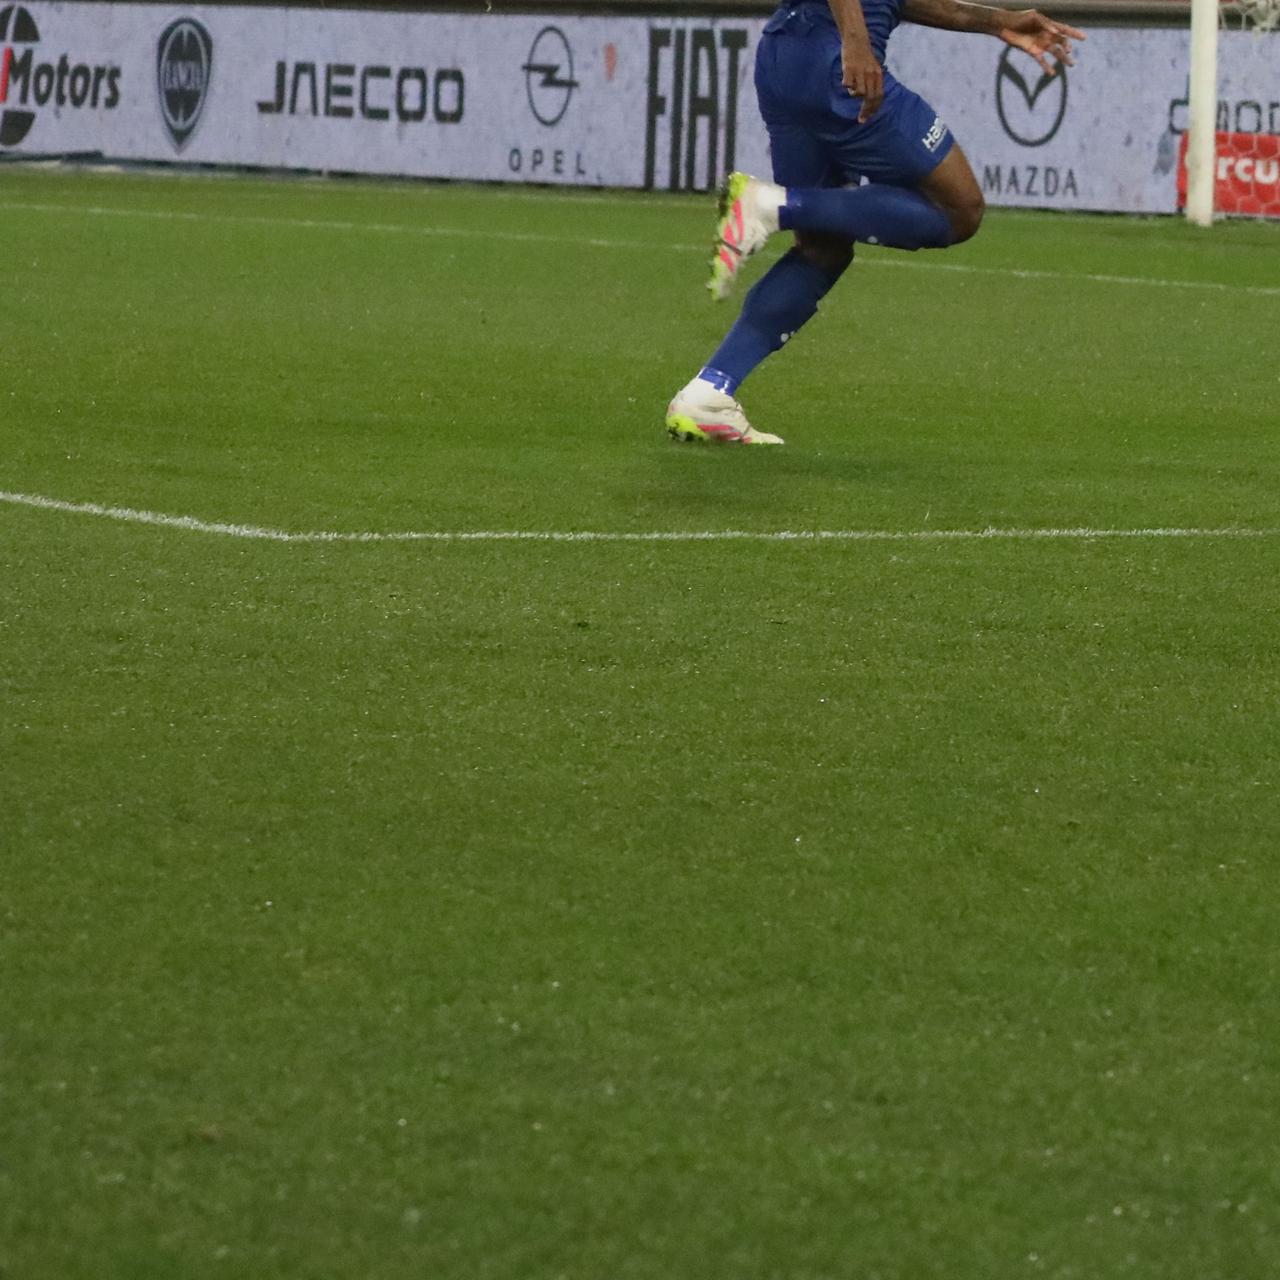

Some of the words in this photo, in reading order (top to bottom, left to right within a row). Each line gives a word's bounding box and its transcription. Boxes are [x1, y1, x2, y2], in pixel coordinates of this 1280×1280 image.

[2, 46, 121, 110] Motors
[256, 61, 465, 124] JAECOO
[645, 28, 748, 191] FIAT
[509, 148, 586, 175] OPEL
[983, 164, 1078, 198] MAZDA
